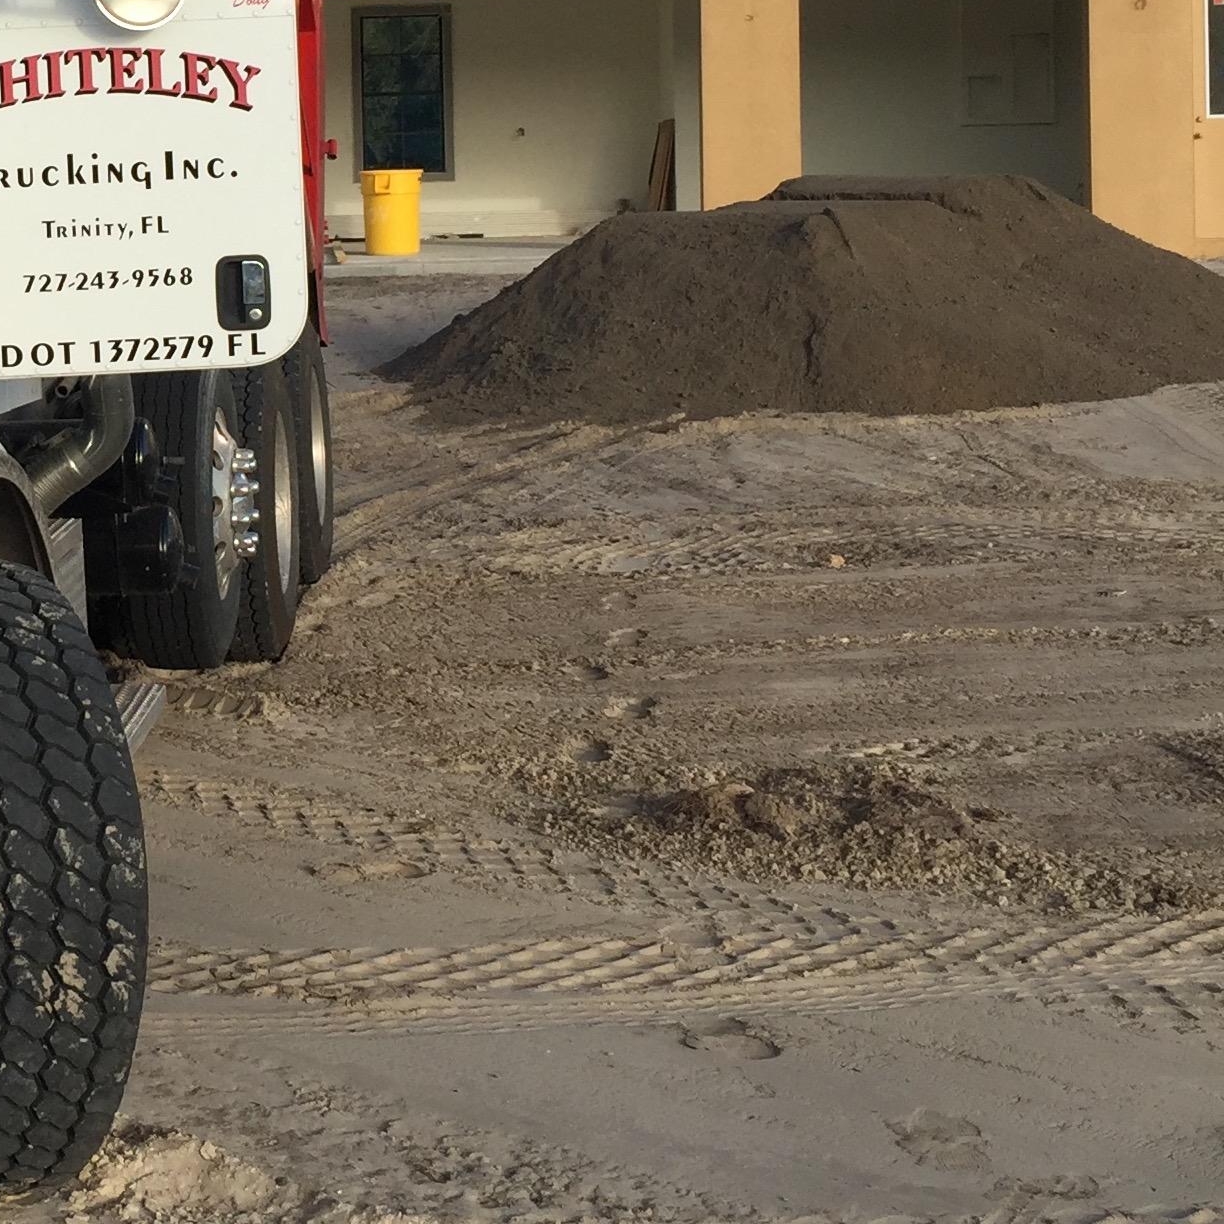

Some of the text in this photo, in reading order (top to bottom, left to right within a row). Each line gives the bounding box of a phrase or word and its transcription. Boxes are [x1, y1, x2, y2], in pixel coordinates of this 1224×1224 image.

[141, 215, 169, 234] FL
[23, 266, 194, 293] 727-243-9568
[1, 341, 76, 368] DOT
[89, 334, 214, 364] 1372579
[227, 332, 266, 357] FL
